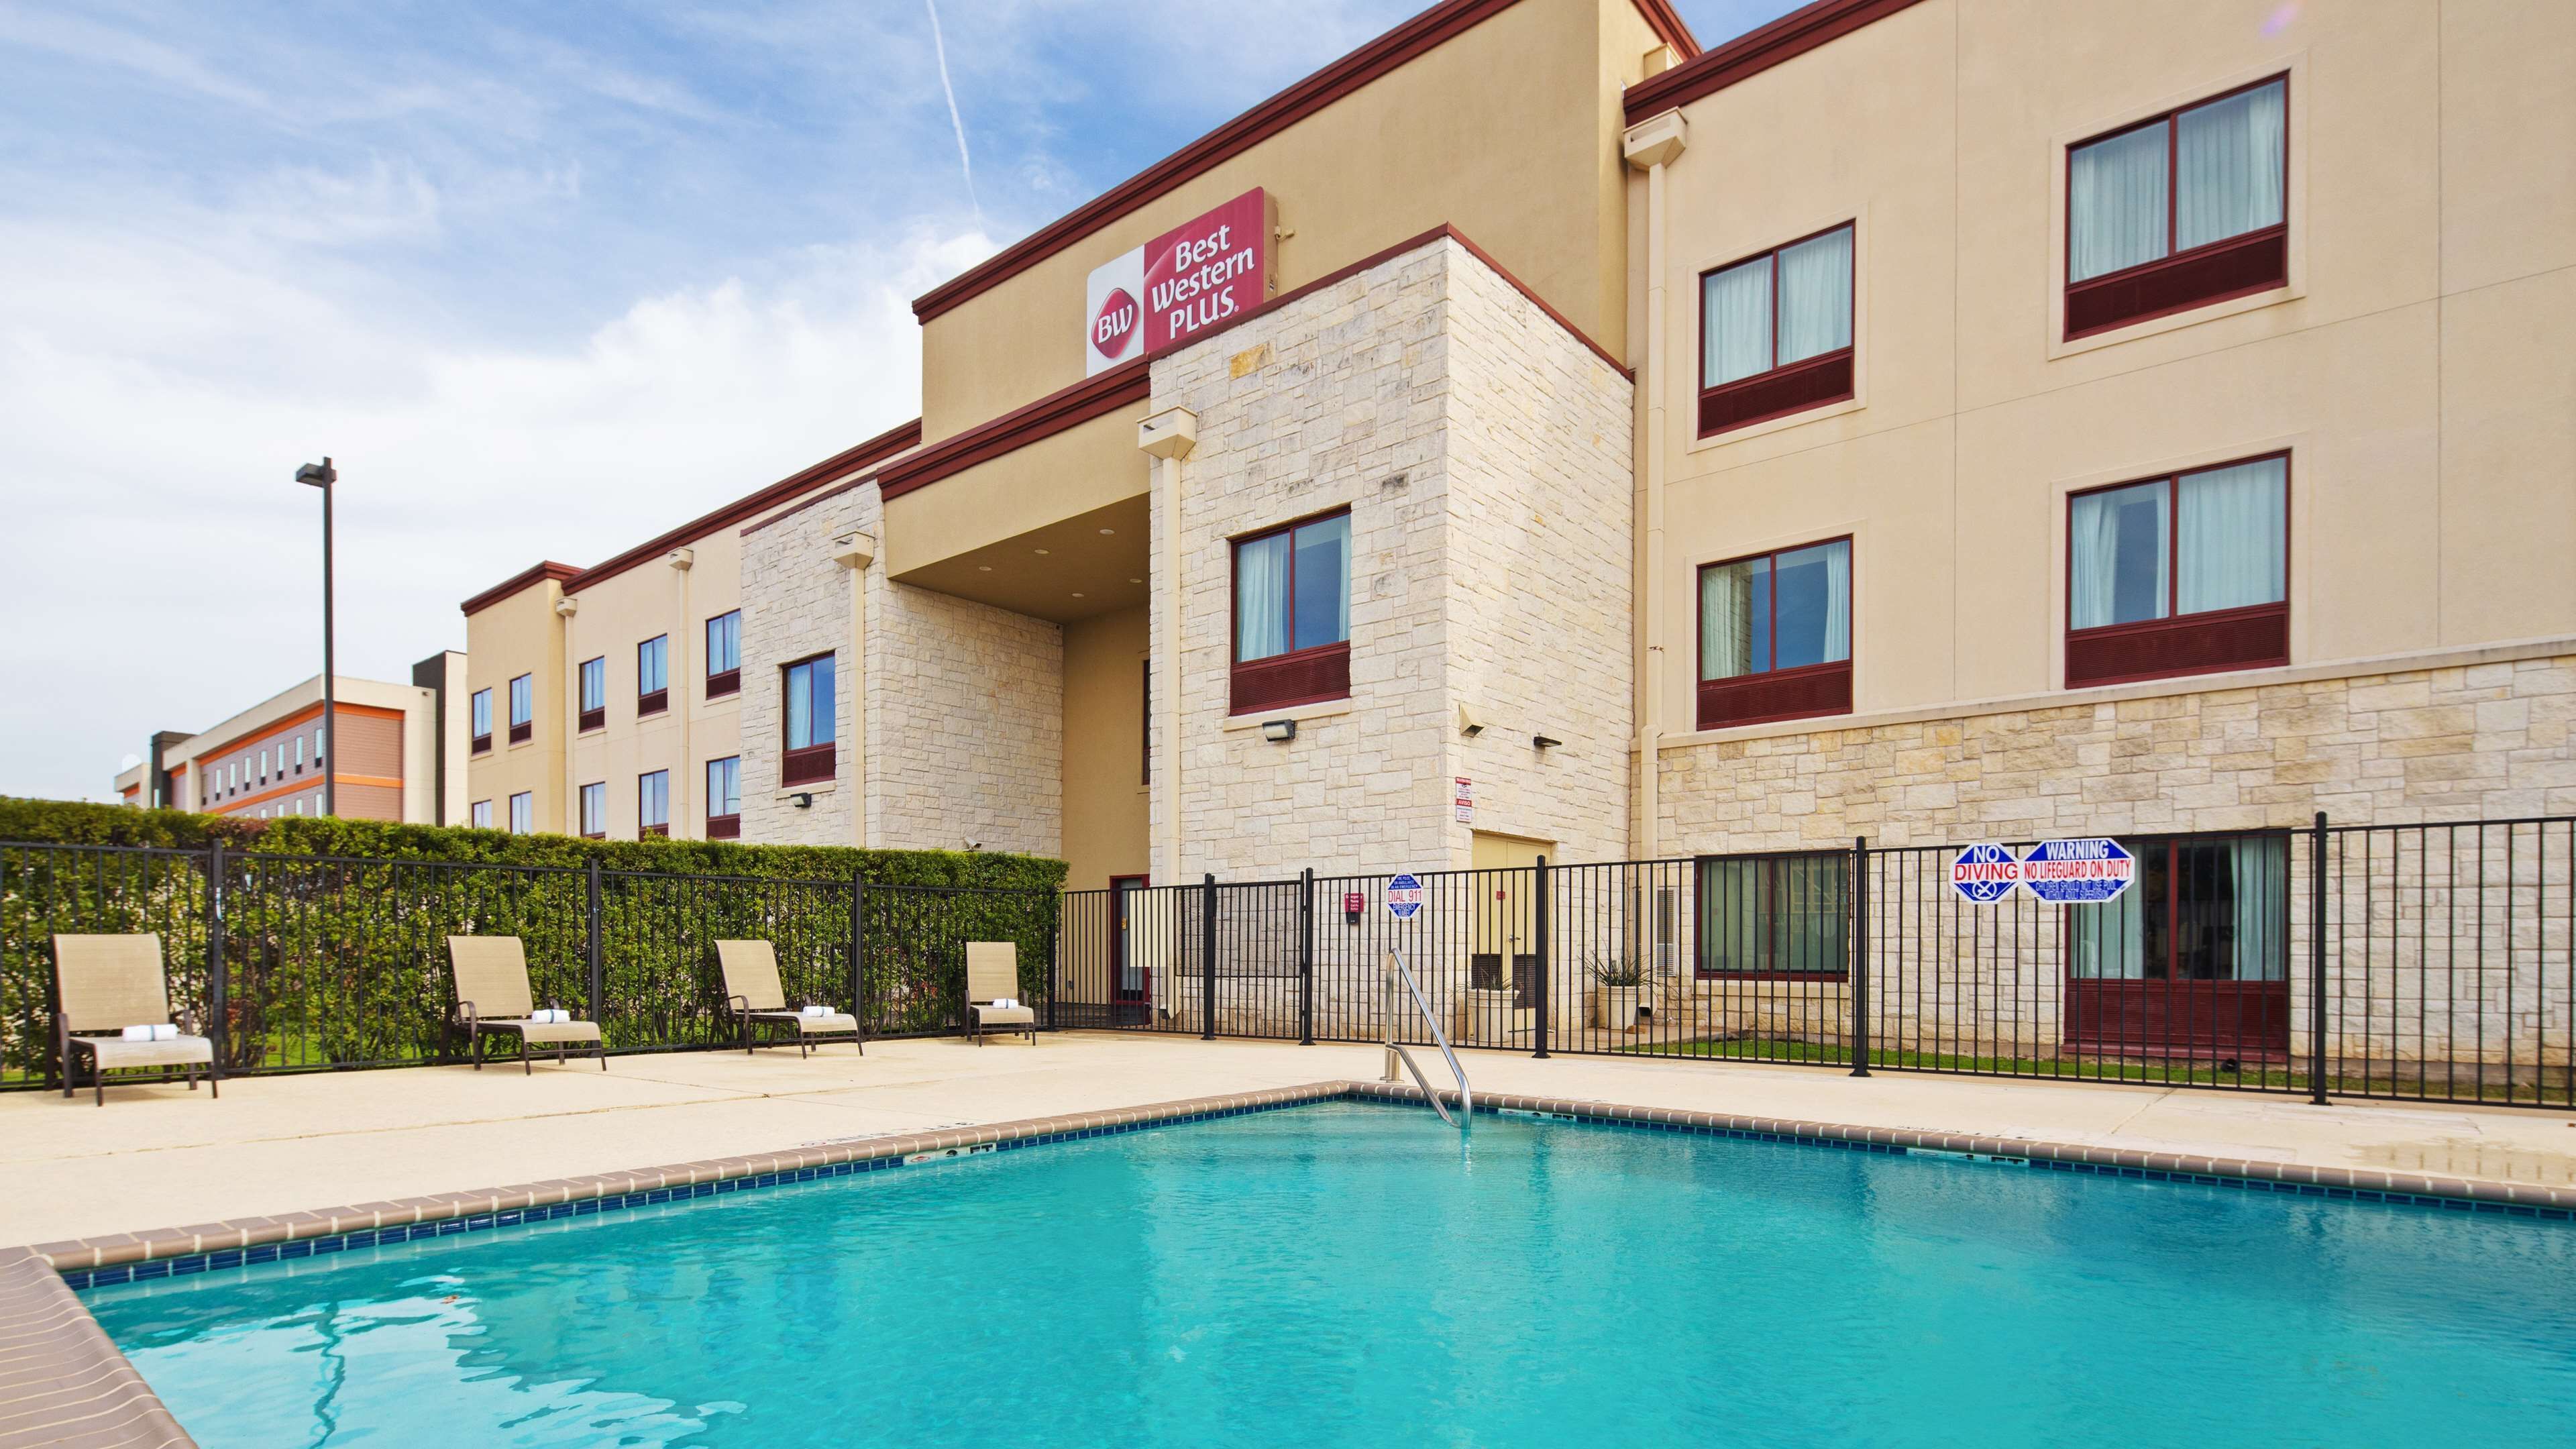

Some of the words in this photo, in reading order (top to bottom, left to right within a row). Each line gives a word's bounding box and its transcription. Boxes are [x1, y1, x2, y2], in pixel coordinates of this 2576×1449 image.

[1175, 224, 1230, 273] Best
[1151, 247, 1254, 313] Western
[1097, 304, 1133, 343] BW
[1973, 845, 2000, 863] NO
[2046, 840, 2109, 860] WARNING
[1955, 863, 2018, 881] DIVING
[2025, 862, 2037, 879] NO
[2040, 861, 2087, 879] LIFEGUARD
[2090, 861, 2103, 877] ON
[2107, 859, 2131, 877] DUTY
[1388, 890, 1405, 902] DIAL
[1409, 890, 1421, 902] 911
[2035, 881, 2059, 892] CHILDREN
